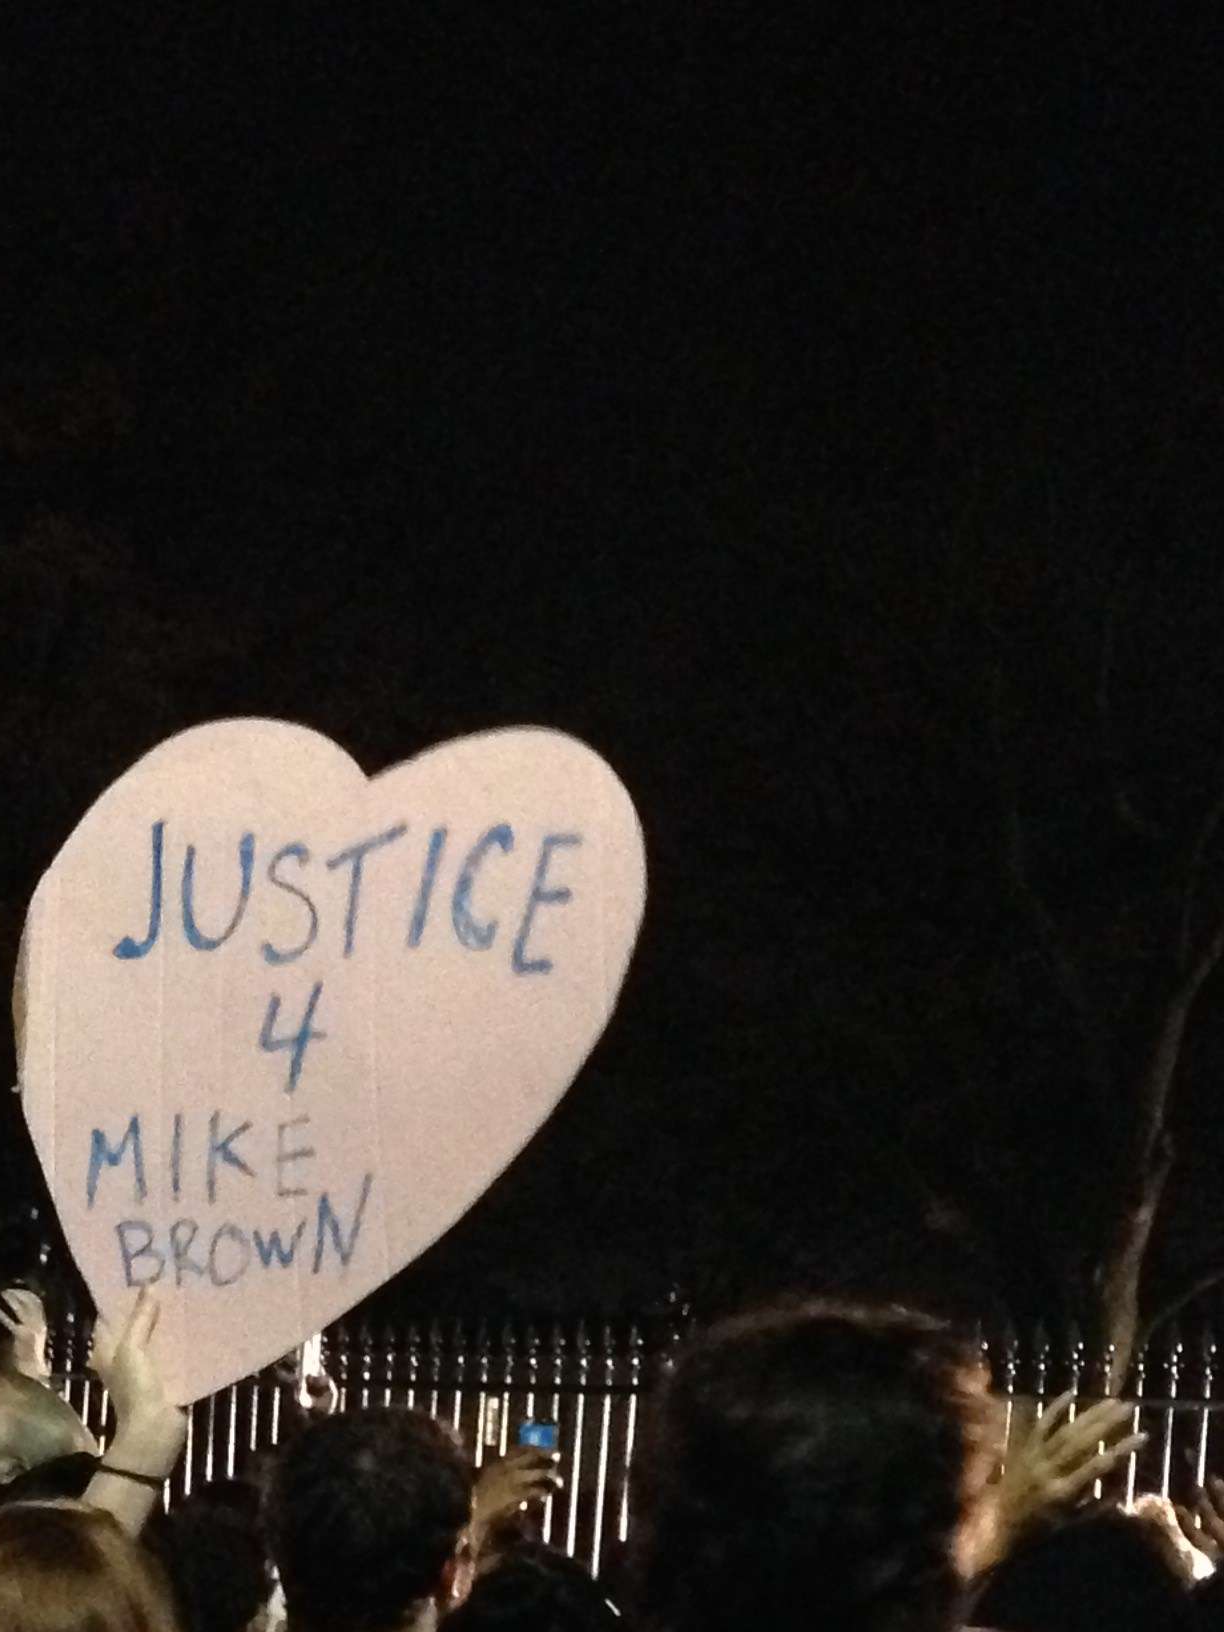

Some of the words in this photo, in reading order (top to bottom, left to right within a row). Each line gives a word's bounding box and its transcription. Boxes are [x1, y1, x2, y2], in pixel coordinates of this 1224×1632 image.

[114, 819, 582, 974] JUSTICE
[258, 980, 326, 1094] 4
[86, 1109, 318, 1211] MIKE
[114, 1173, 374, 1289] BROWN
